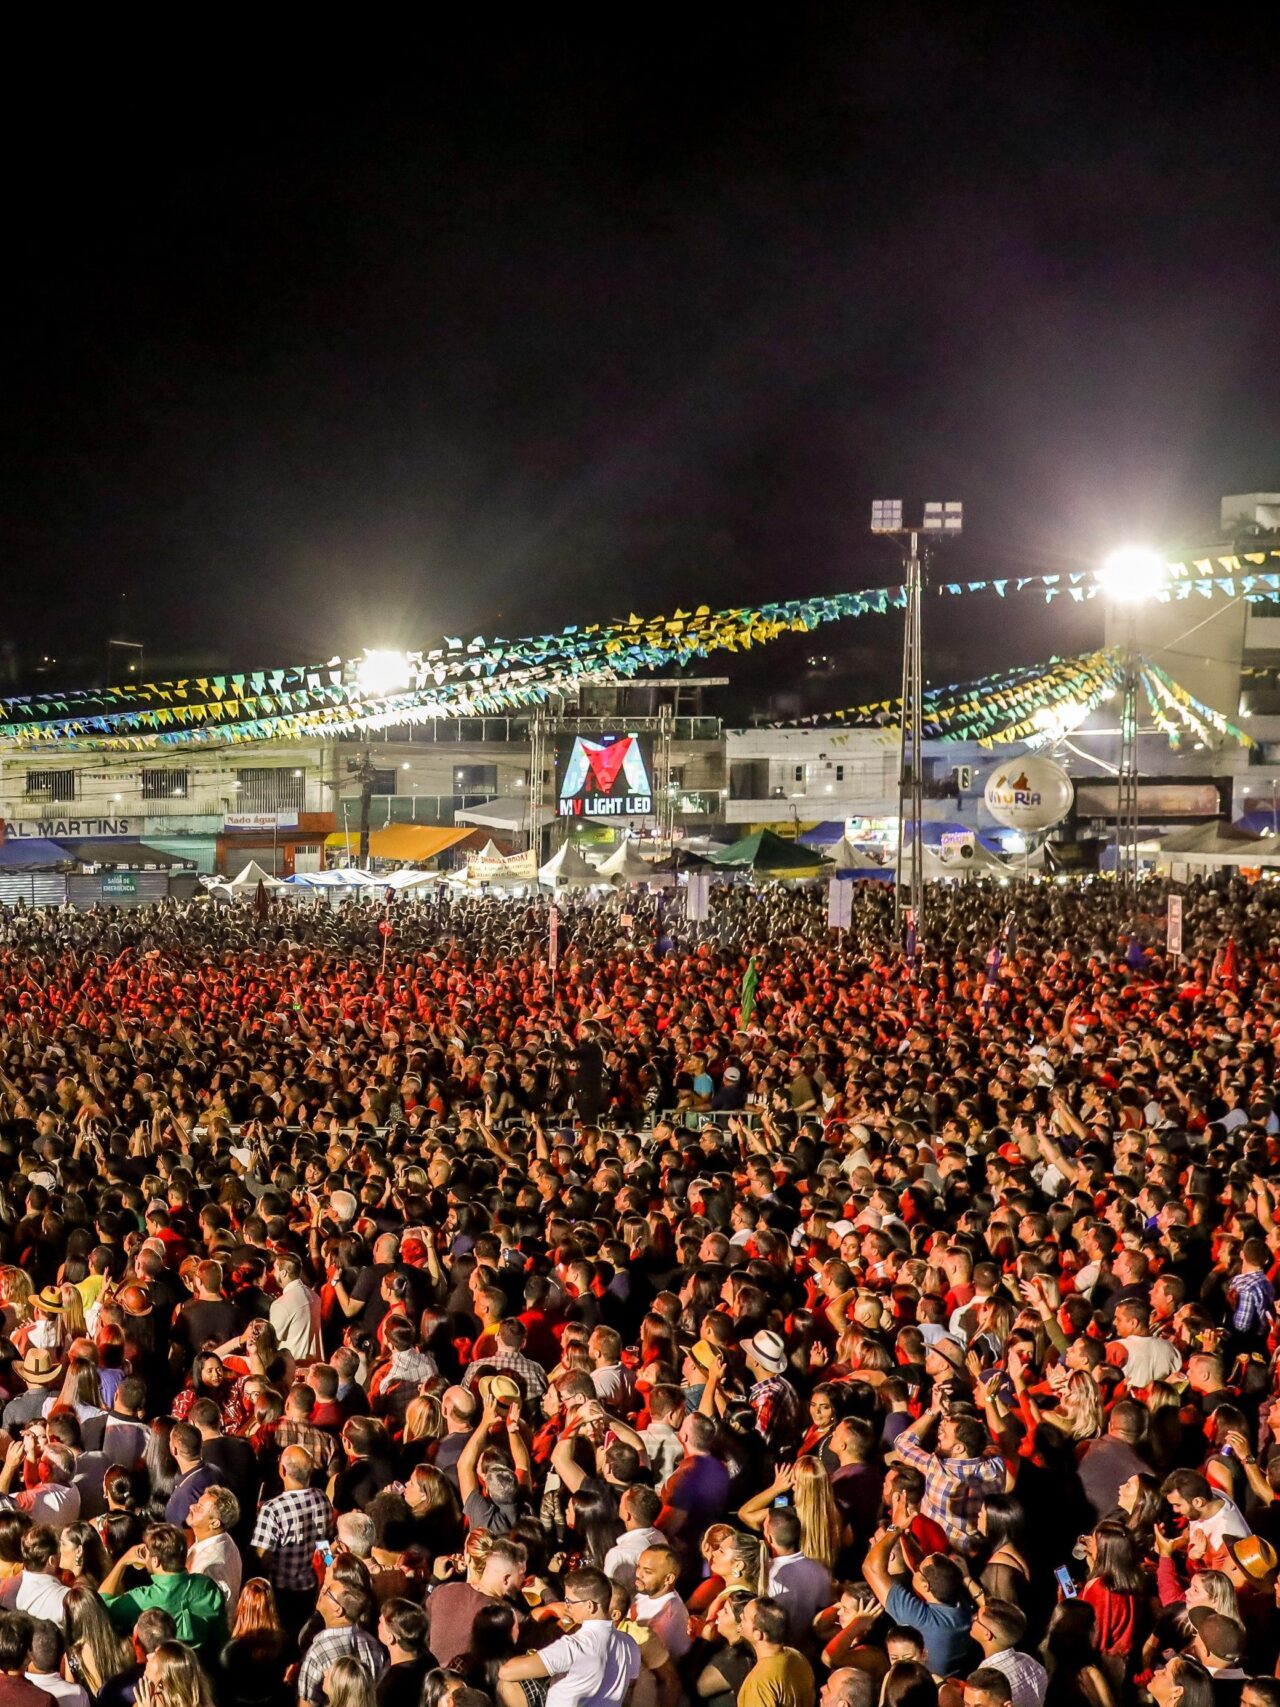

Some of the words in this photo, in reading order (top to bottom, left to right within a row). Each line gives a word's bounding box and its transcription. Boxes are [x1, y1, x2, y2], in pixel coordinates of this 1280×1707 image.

[560, 799, 582, 816] MV
[625, 797, 651, 814] LED
[38, 820, 129, 837] MARTINS
[228, 816, 251, 824] Nado
[254, 816, 276, 825] água
